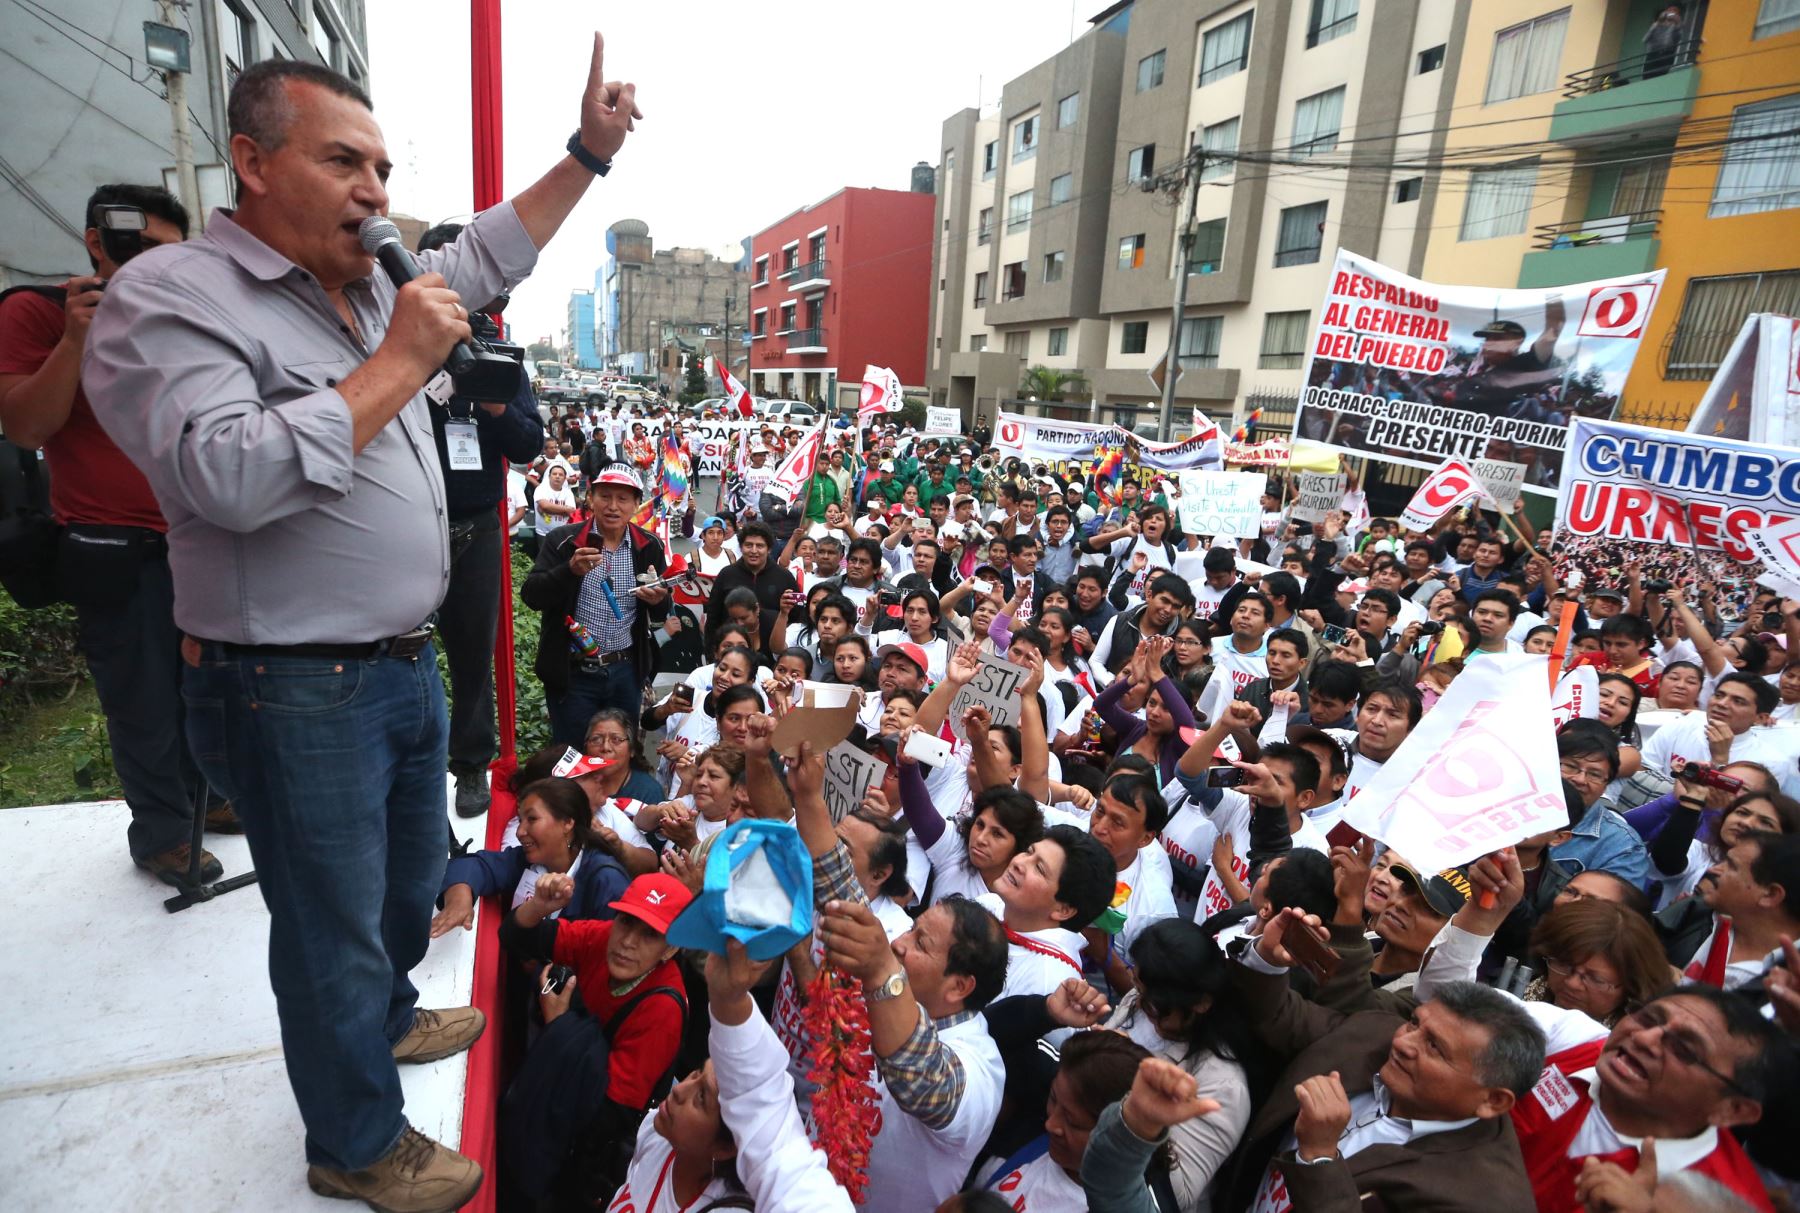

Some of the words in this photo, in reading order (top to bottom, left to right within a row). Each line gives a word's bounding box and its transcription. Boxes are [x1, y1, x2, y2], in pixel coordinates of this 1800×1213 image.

[1332, 271, 1439, 313] RESPALDO
[1323, 302, 1350, 328] AL
[1354, 306, 1450, 342] GENERAL
[1316, 332, 1353, 360] DEL
[1357, 337, 1446, 373] PUEBLO
[1037, 428, 1081, 444] PARTIDO
[1369, 418, 1487, 460] PRESENTE
[1191, 515, 1251, 535] SOS!!
[1569, 483, 1796, 562] URRES
[1166, 836, 1198, 870] VOTO
